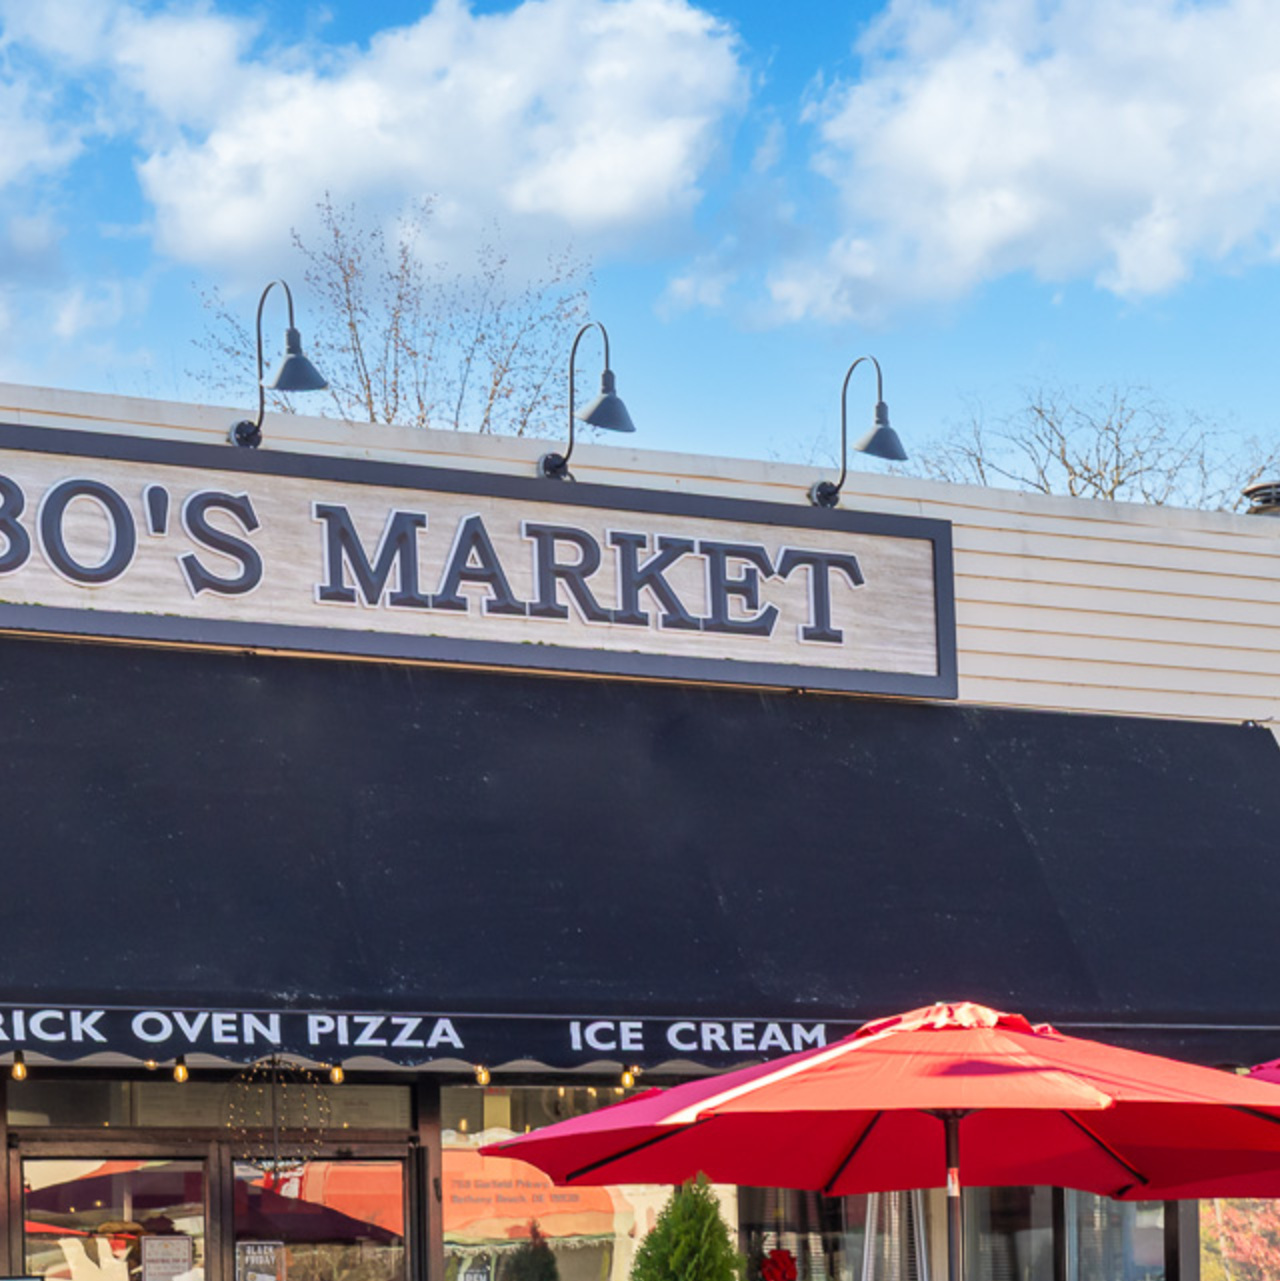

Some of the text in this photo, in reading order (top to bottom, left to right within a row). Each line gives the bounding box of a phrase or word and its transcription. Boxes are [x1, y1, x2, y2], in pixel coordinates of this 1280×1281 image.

[313, 502, 865, 647] MARKET
[132, 1010, 280, 1045] OVEN
[307, 1014, 464, 1049] PIZZA
[570, 1020, 827, 1052] ICE CREAM
[245, 1255, 276, 1265] FRIDAY
